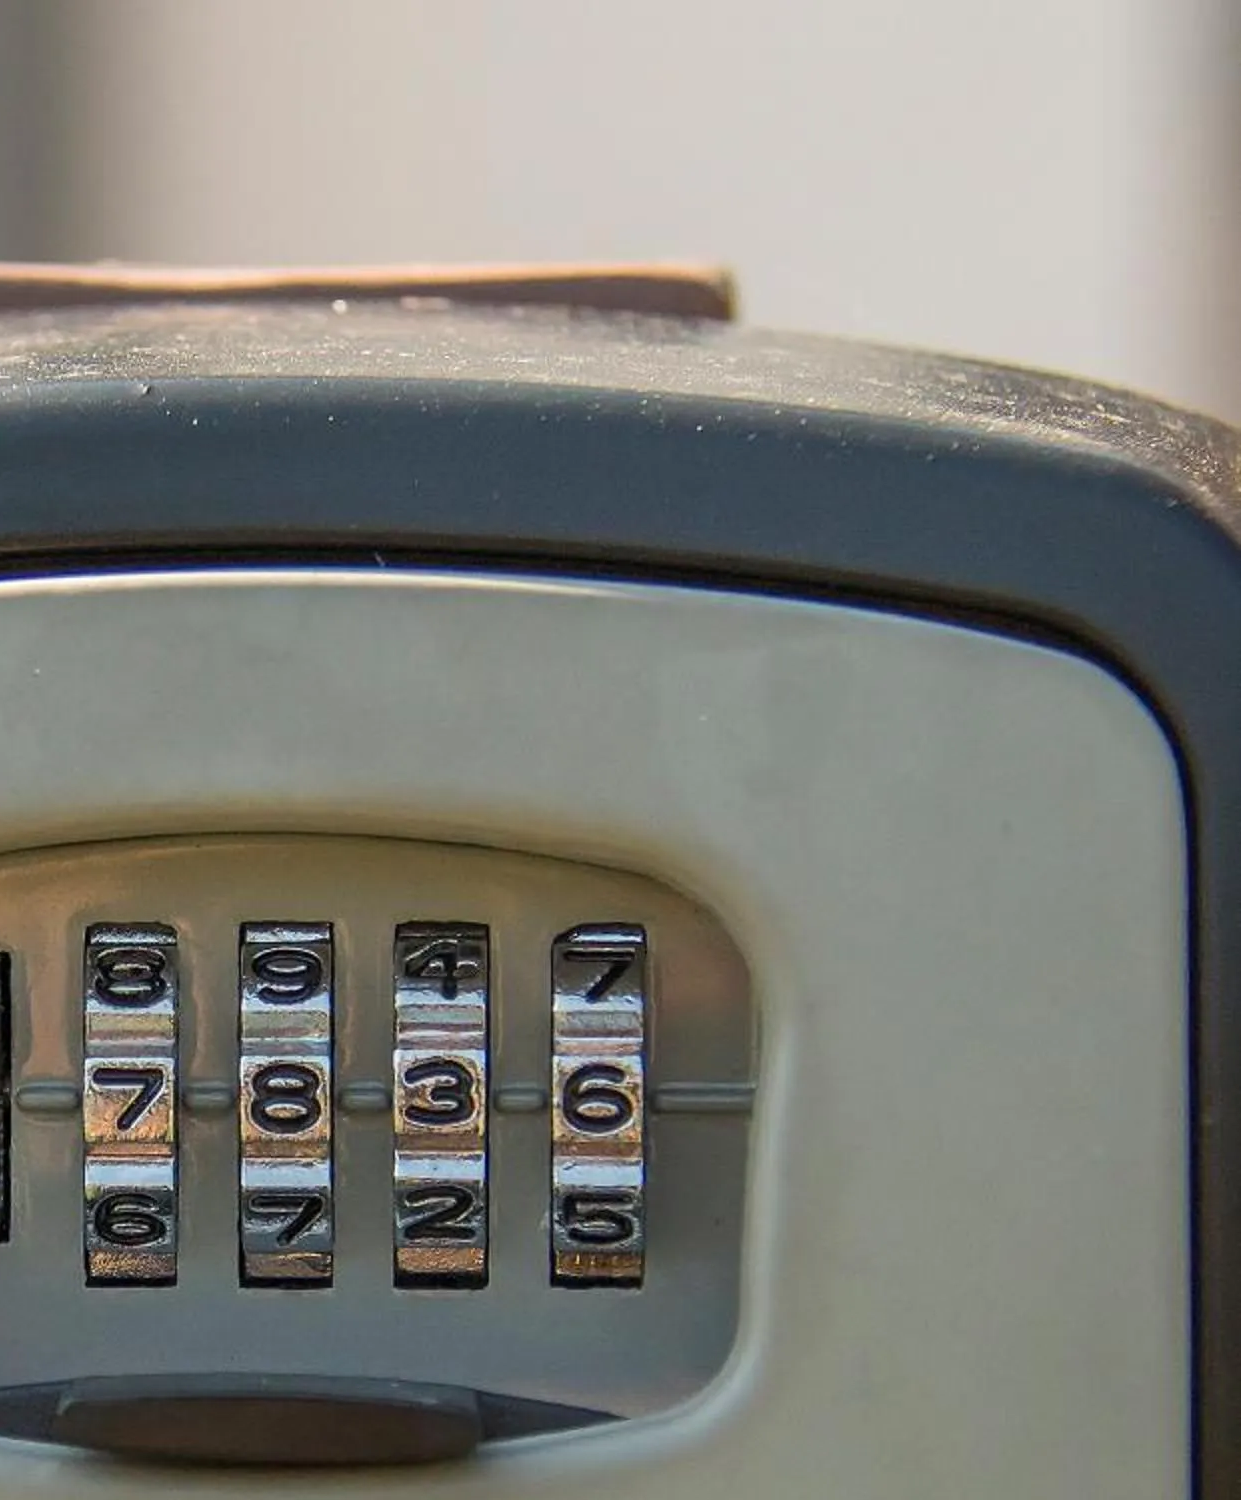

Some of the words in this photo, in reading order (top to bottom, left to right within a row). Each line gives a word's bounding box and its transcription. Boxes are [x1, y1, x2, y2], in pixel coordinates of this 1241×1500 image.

[95, 947, 166, 1003] 8
[252, 947, 322, 1001] 9
[405, 940, 479, 999] 4
[563, 946, 635, 1002] 7
[92, 1066, 164, 1130] 7
[251, 1063, 322, 1134] 8
[404, 1060, 476, 1126] 3
[562, 1063, 634, 1133] 6
[94, 1193, 166, 1245] 6
[250, 1194, 323, 1245] 7
[404, 1184, 476, 1239] 2
[564, 1193, 634, 1243] 5
